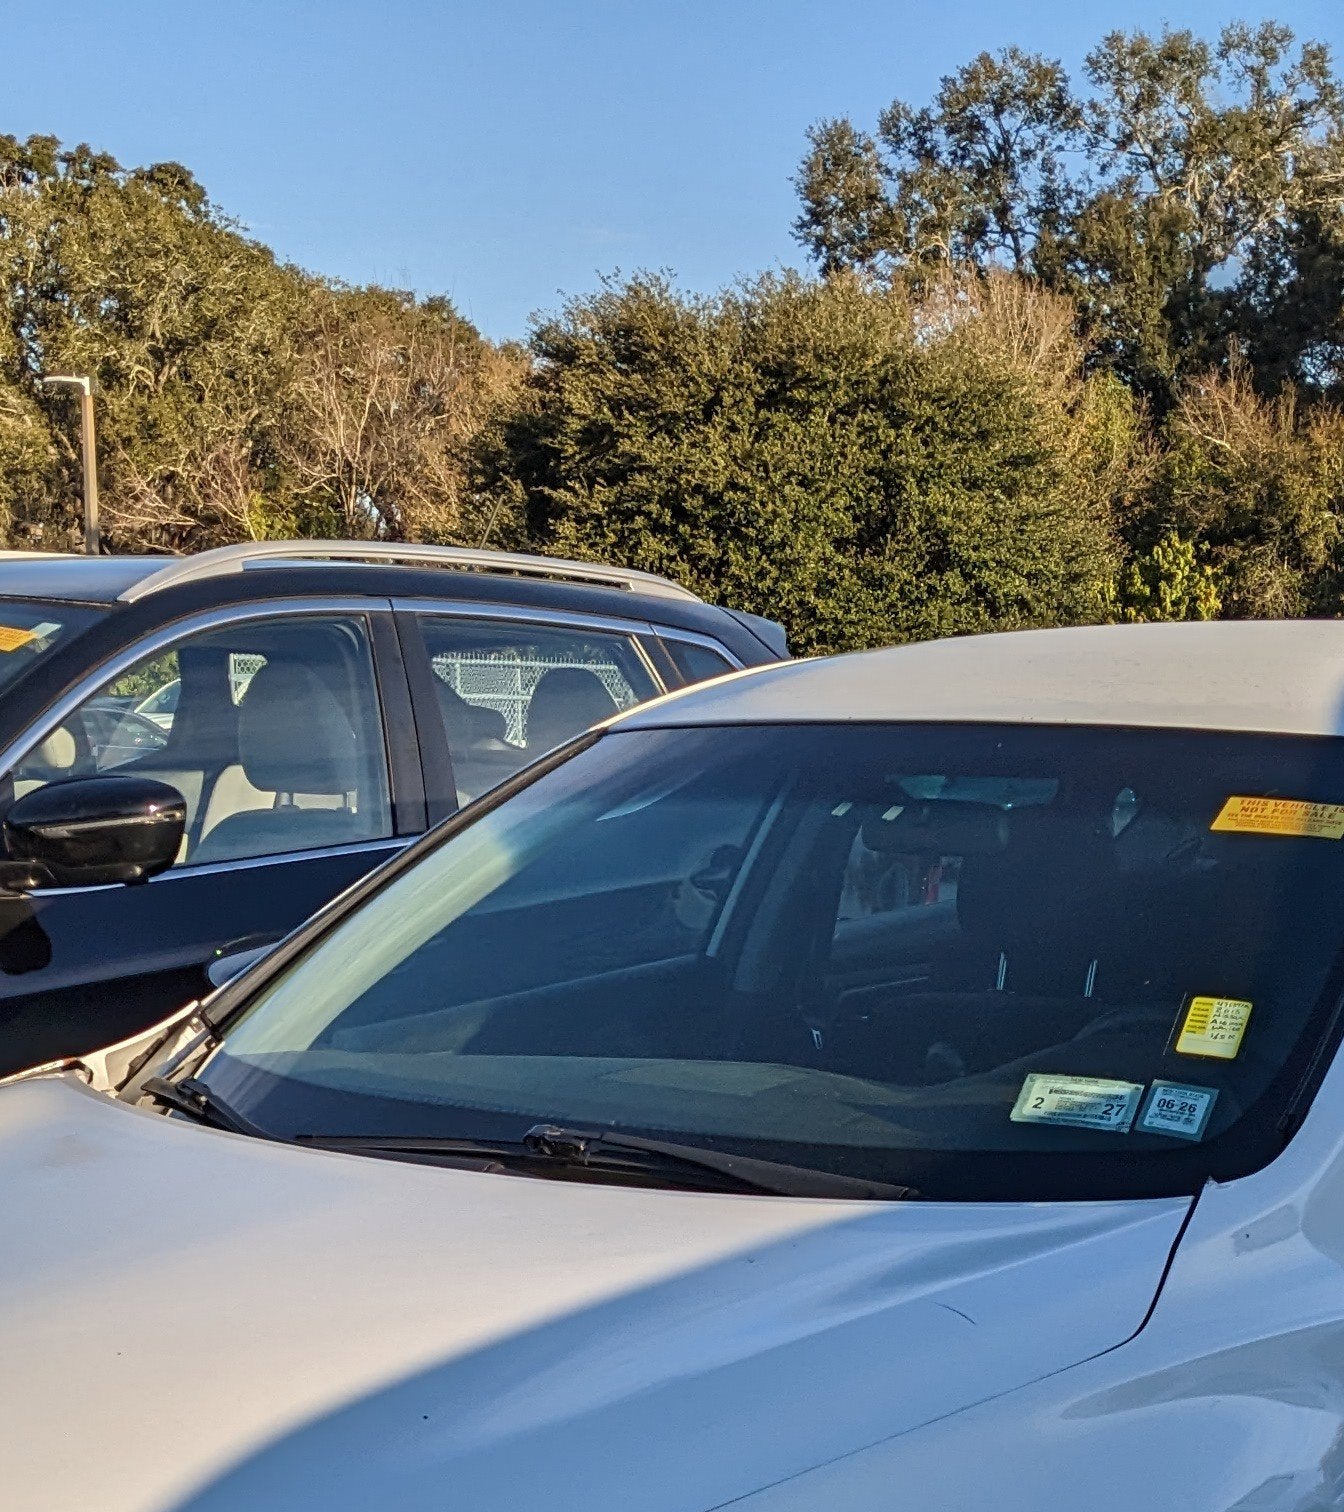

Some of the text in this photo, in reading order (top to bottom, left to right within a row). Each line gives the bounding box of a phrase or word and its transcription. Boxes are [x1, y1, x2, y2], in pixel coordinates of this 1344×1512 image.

[1239, 799, 1269, 808] THIS
[1274, 801, 1329, 811] VEHICLE
[1240, 806, 1266, 814] NOT
[1271, 808, 1297, 816] FOR
[1302, 810, 1337, 820] SALE
[1032, 1096, 1045, 1110] 2
[1102, 1103, 1127, 1117] 27
